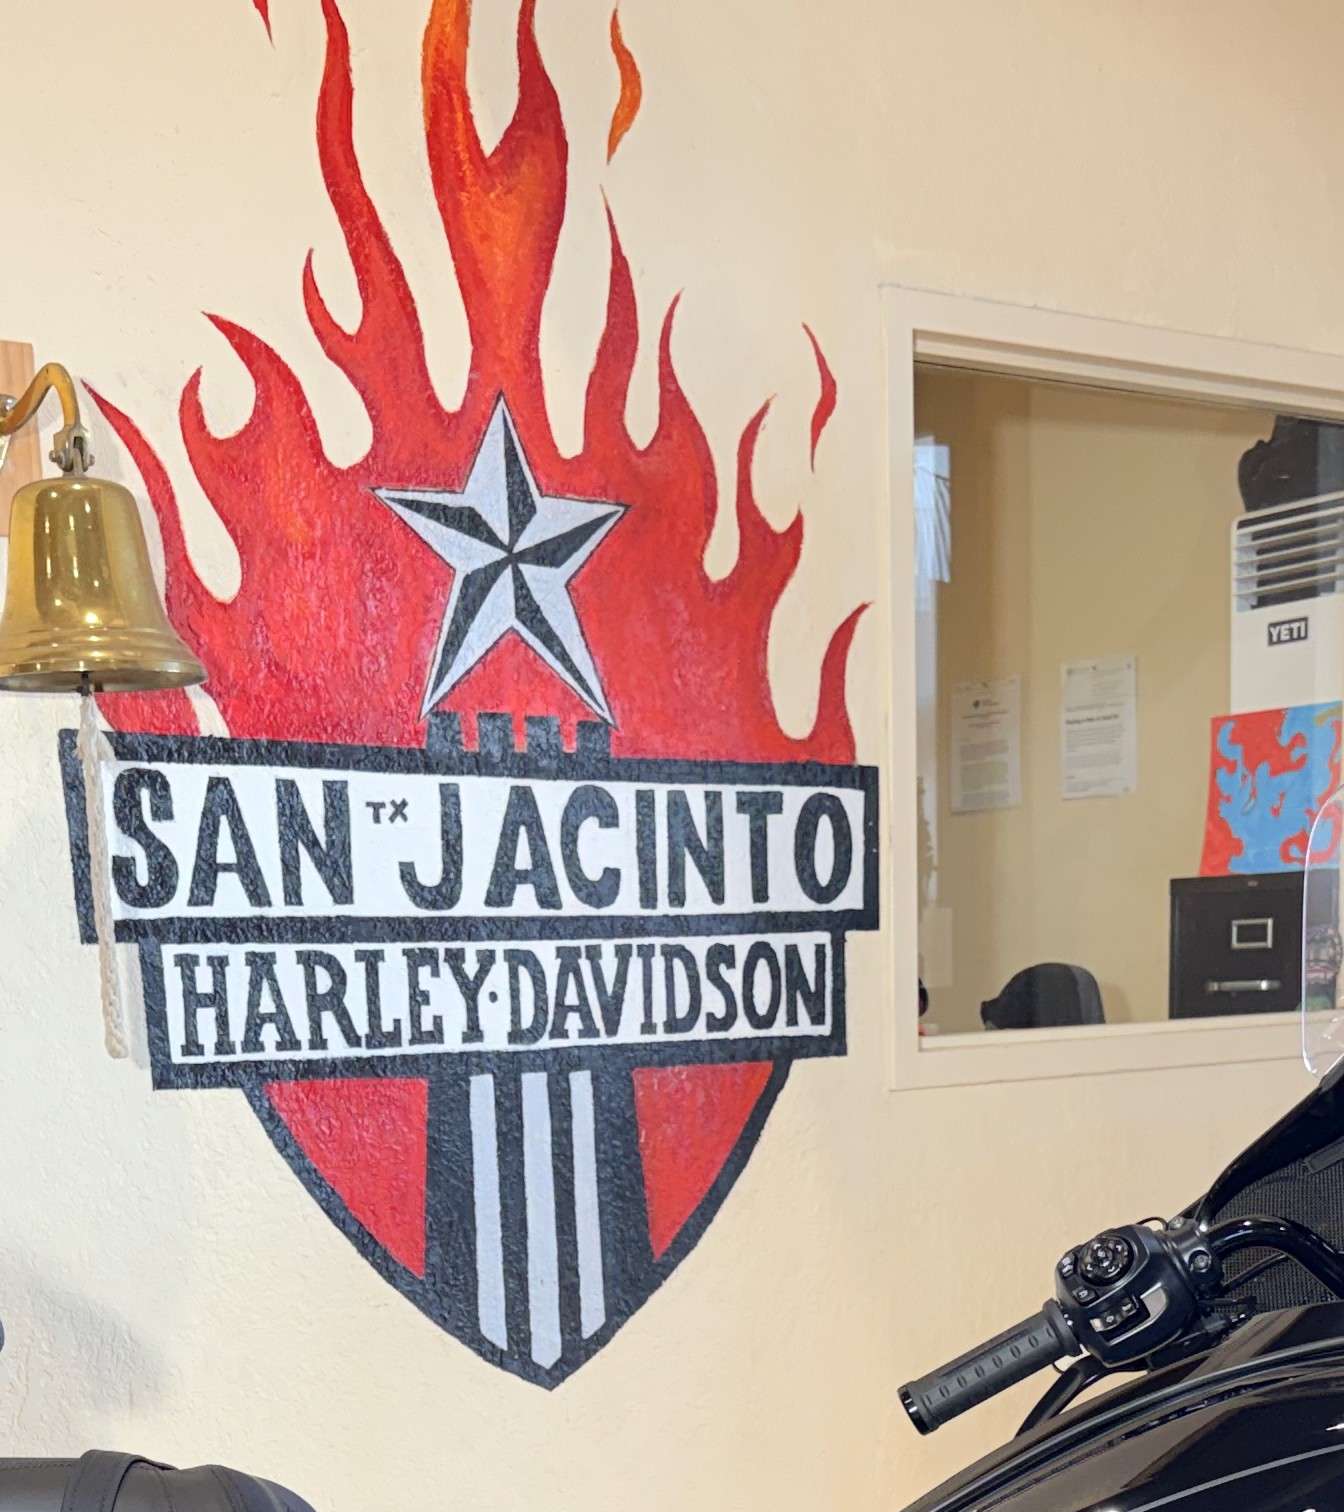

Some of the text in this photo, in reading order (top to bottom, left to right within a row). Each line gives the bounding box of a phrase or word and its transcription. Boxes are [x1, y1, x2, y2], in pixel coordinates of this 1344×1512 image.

[1269, 621, 1306, 643] YETI
[112, 768, 854, 911] SAN TX JACINTO
